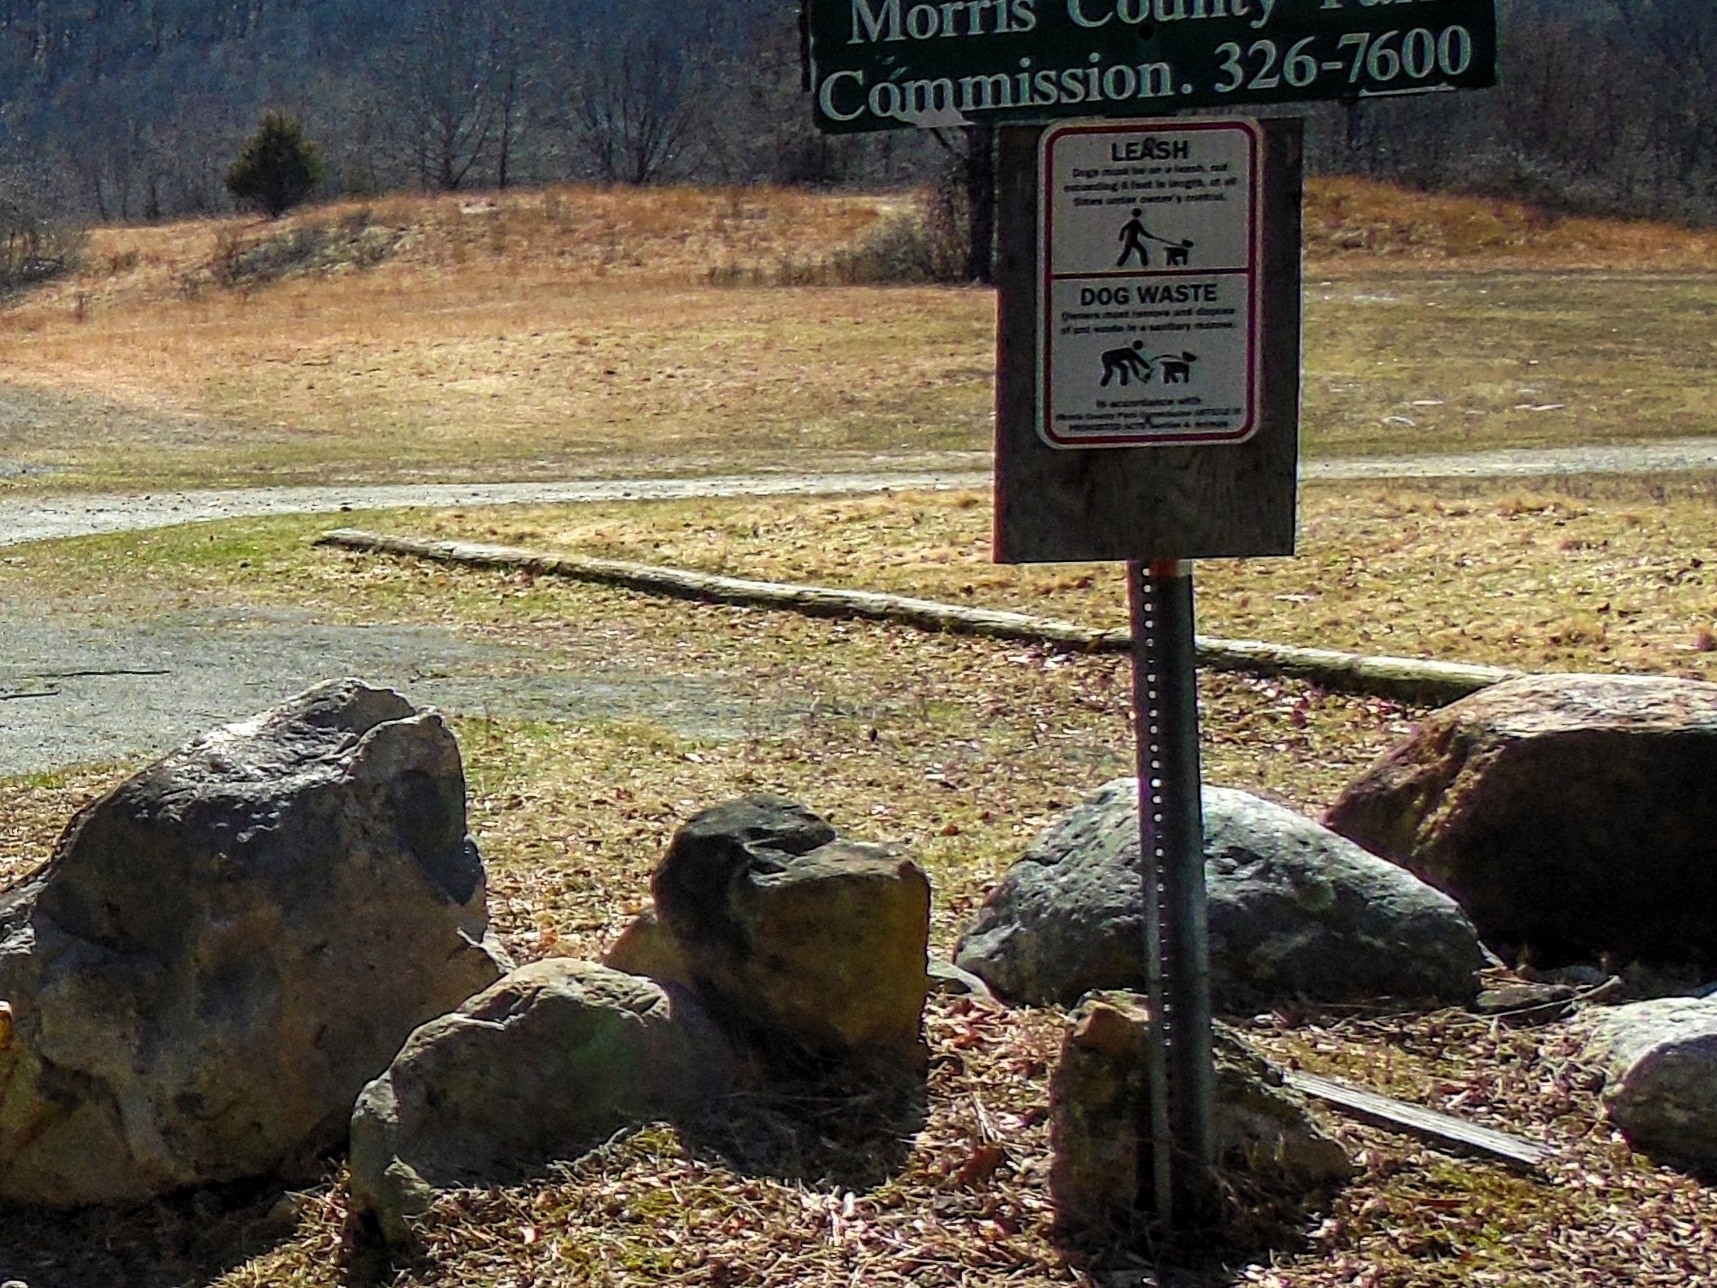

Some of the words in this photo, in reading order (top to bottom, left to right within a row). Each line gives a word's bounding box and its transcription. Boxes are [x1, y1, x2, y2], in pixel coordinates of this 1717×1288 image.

[820, 53, 1192, 121] Commission.
[1214, 26, 1472, 91] 326-7600
[1112, 139, 1188, 162] LEASH
[1080, 288, 1129, 306] DOG
[1137, 283, 1217, 303] WASTE
